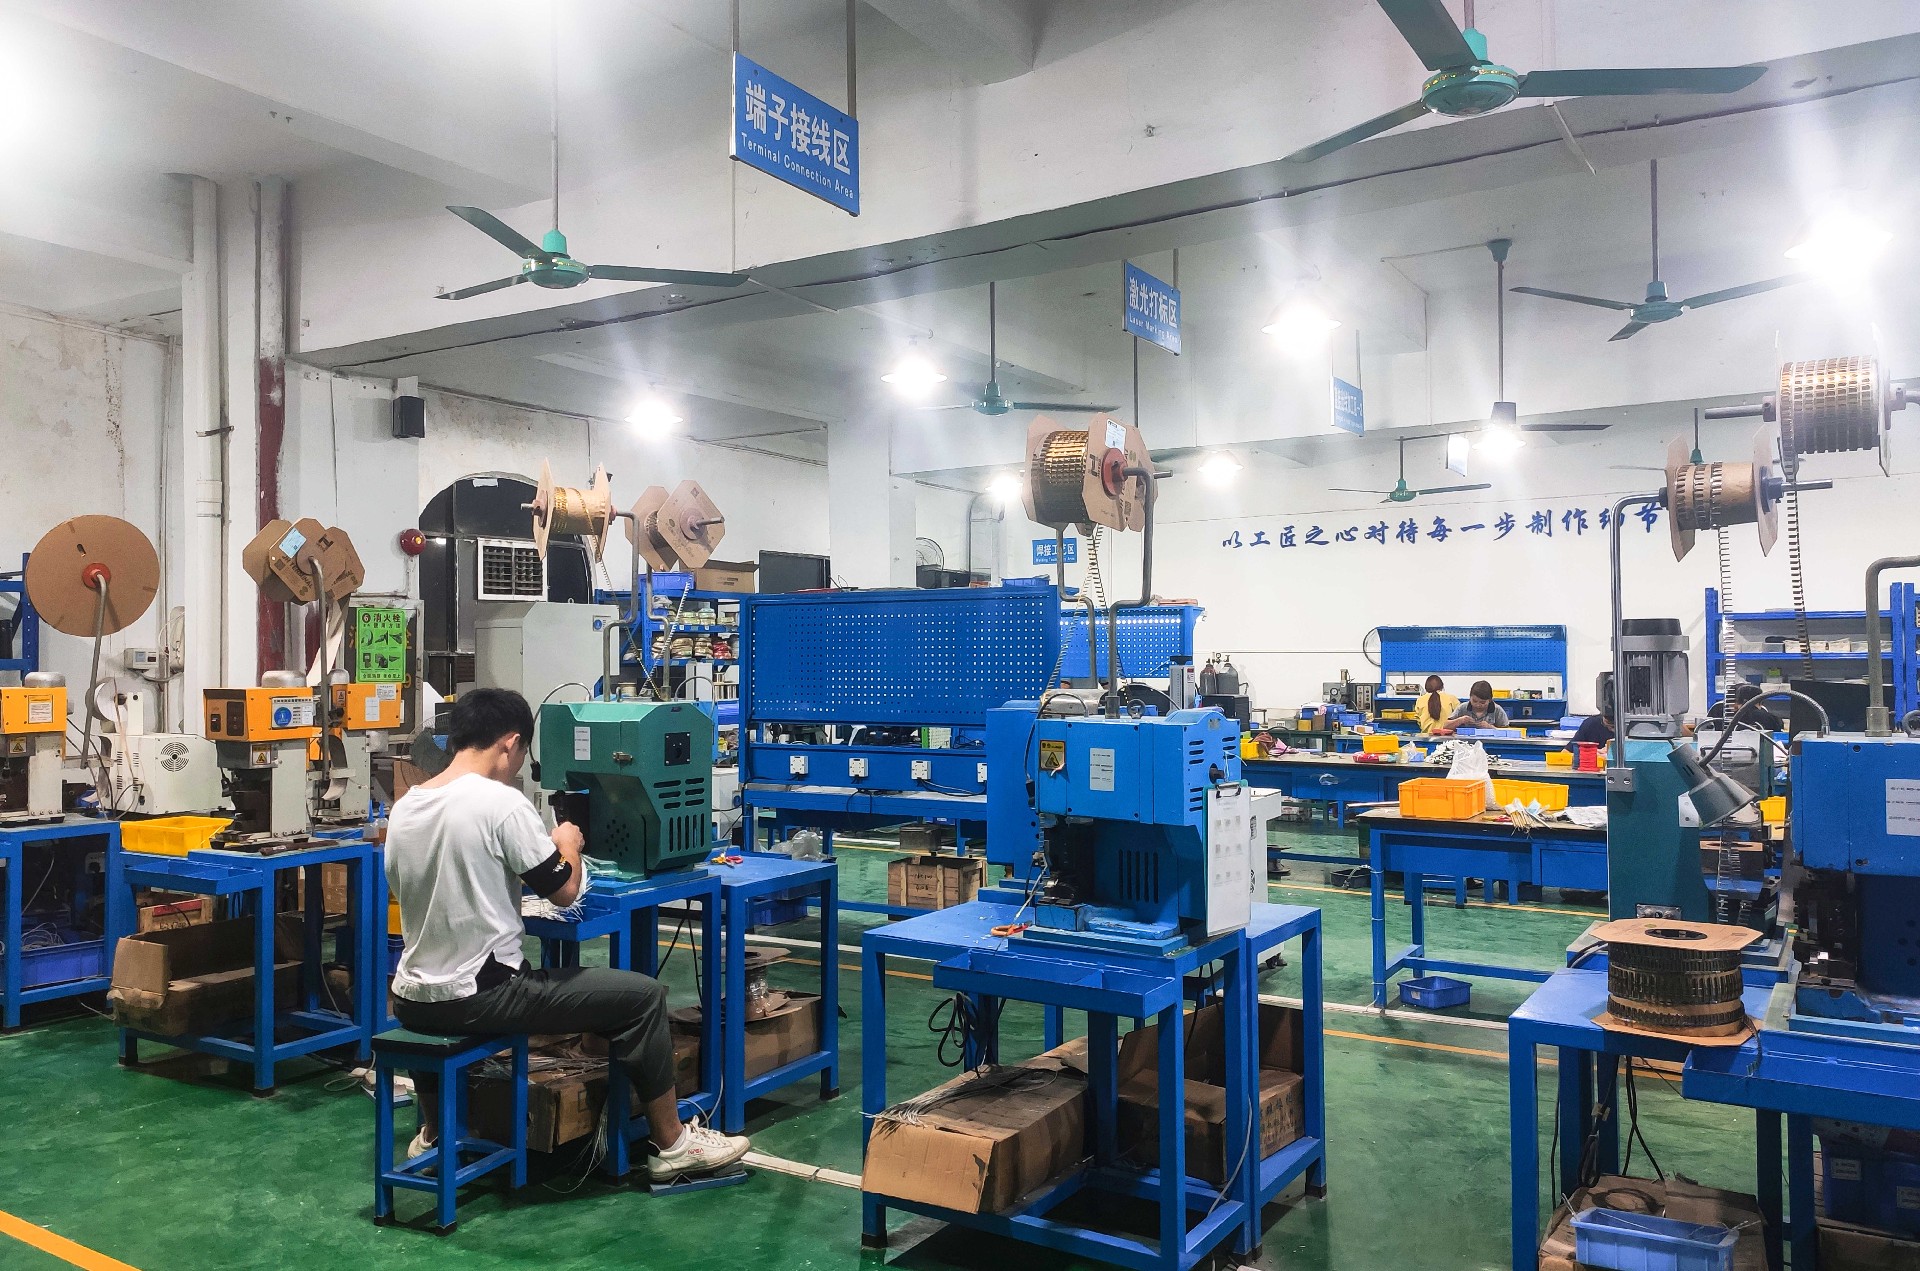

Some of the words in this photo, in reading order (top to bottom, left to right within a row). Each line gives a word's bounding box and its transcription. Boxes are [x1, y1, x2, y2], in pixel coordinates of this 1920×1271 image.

[745, 79, 851, 175] 端子接线区
[741, 132, 781, 164] Terminal
[783, 154, 832, 189] Connection
[834, 178, 854, 199] Area
[1129, 276, 1178, 329] 激光打标区
[373, 612, 401, 623] 消火栓
[688, 1147, 704, 1155] NASA
